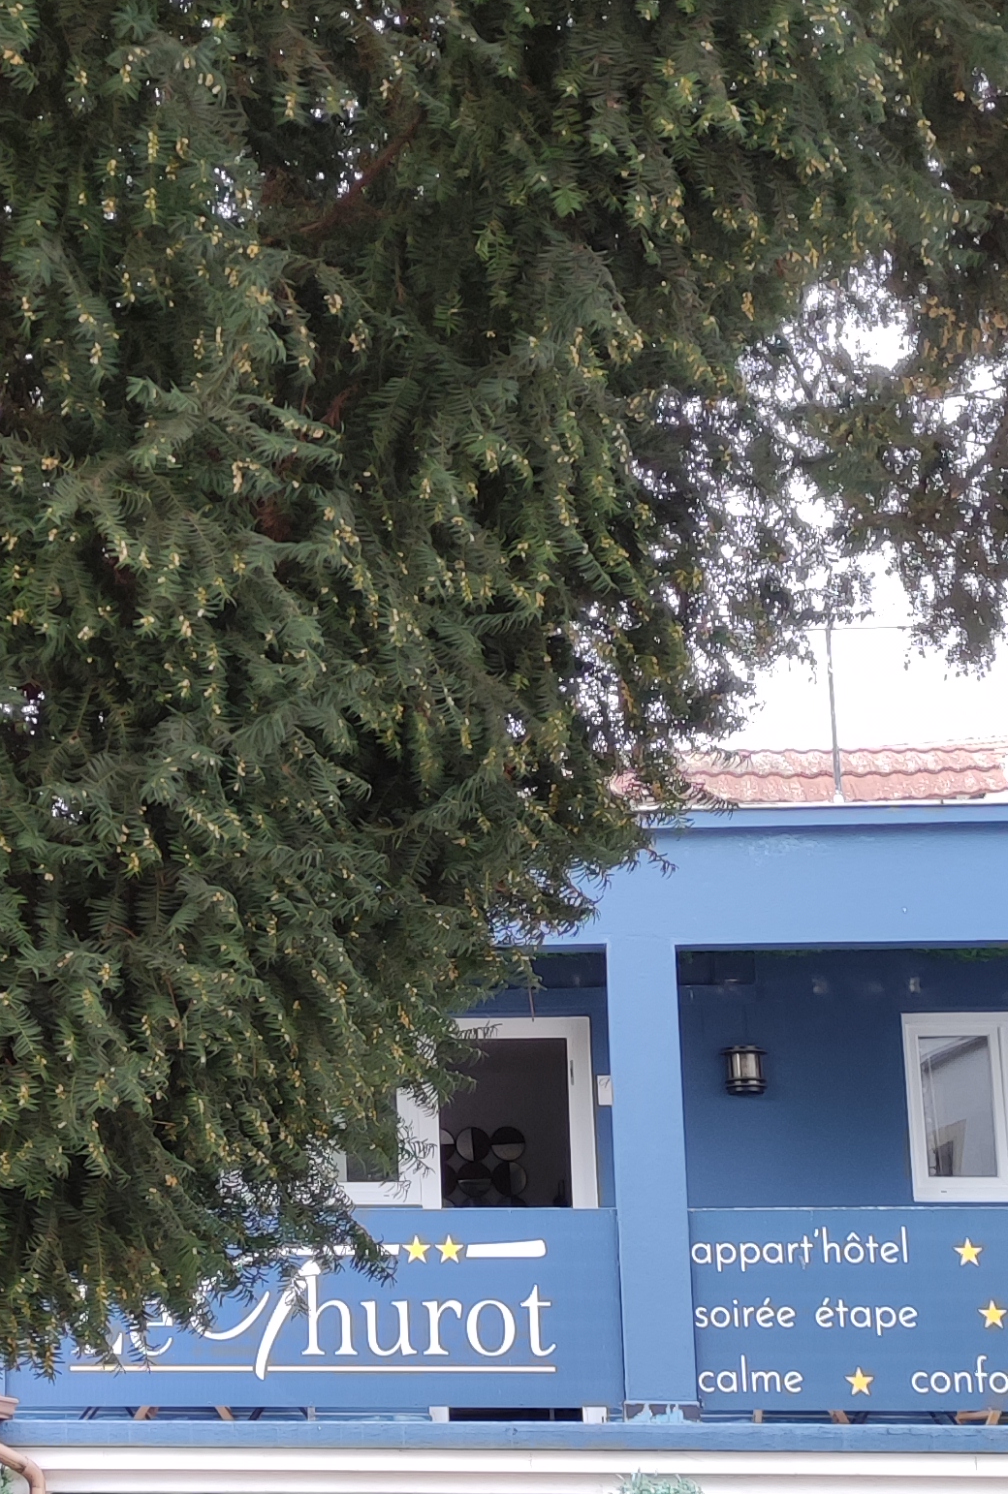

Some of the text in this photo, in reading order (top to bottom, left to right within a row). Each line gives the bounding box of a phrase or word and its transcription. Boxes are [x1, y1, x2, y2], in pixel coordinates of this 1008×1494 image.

[691, 1226, 909, 1272] appart'hôtel
[71, 1270, 174, 1356] e
[694, 1297, 918, 1336] soirée étape
[698, 1354, 804, 1394] calme
